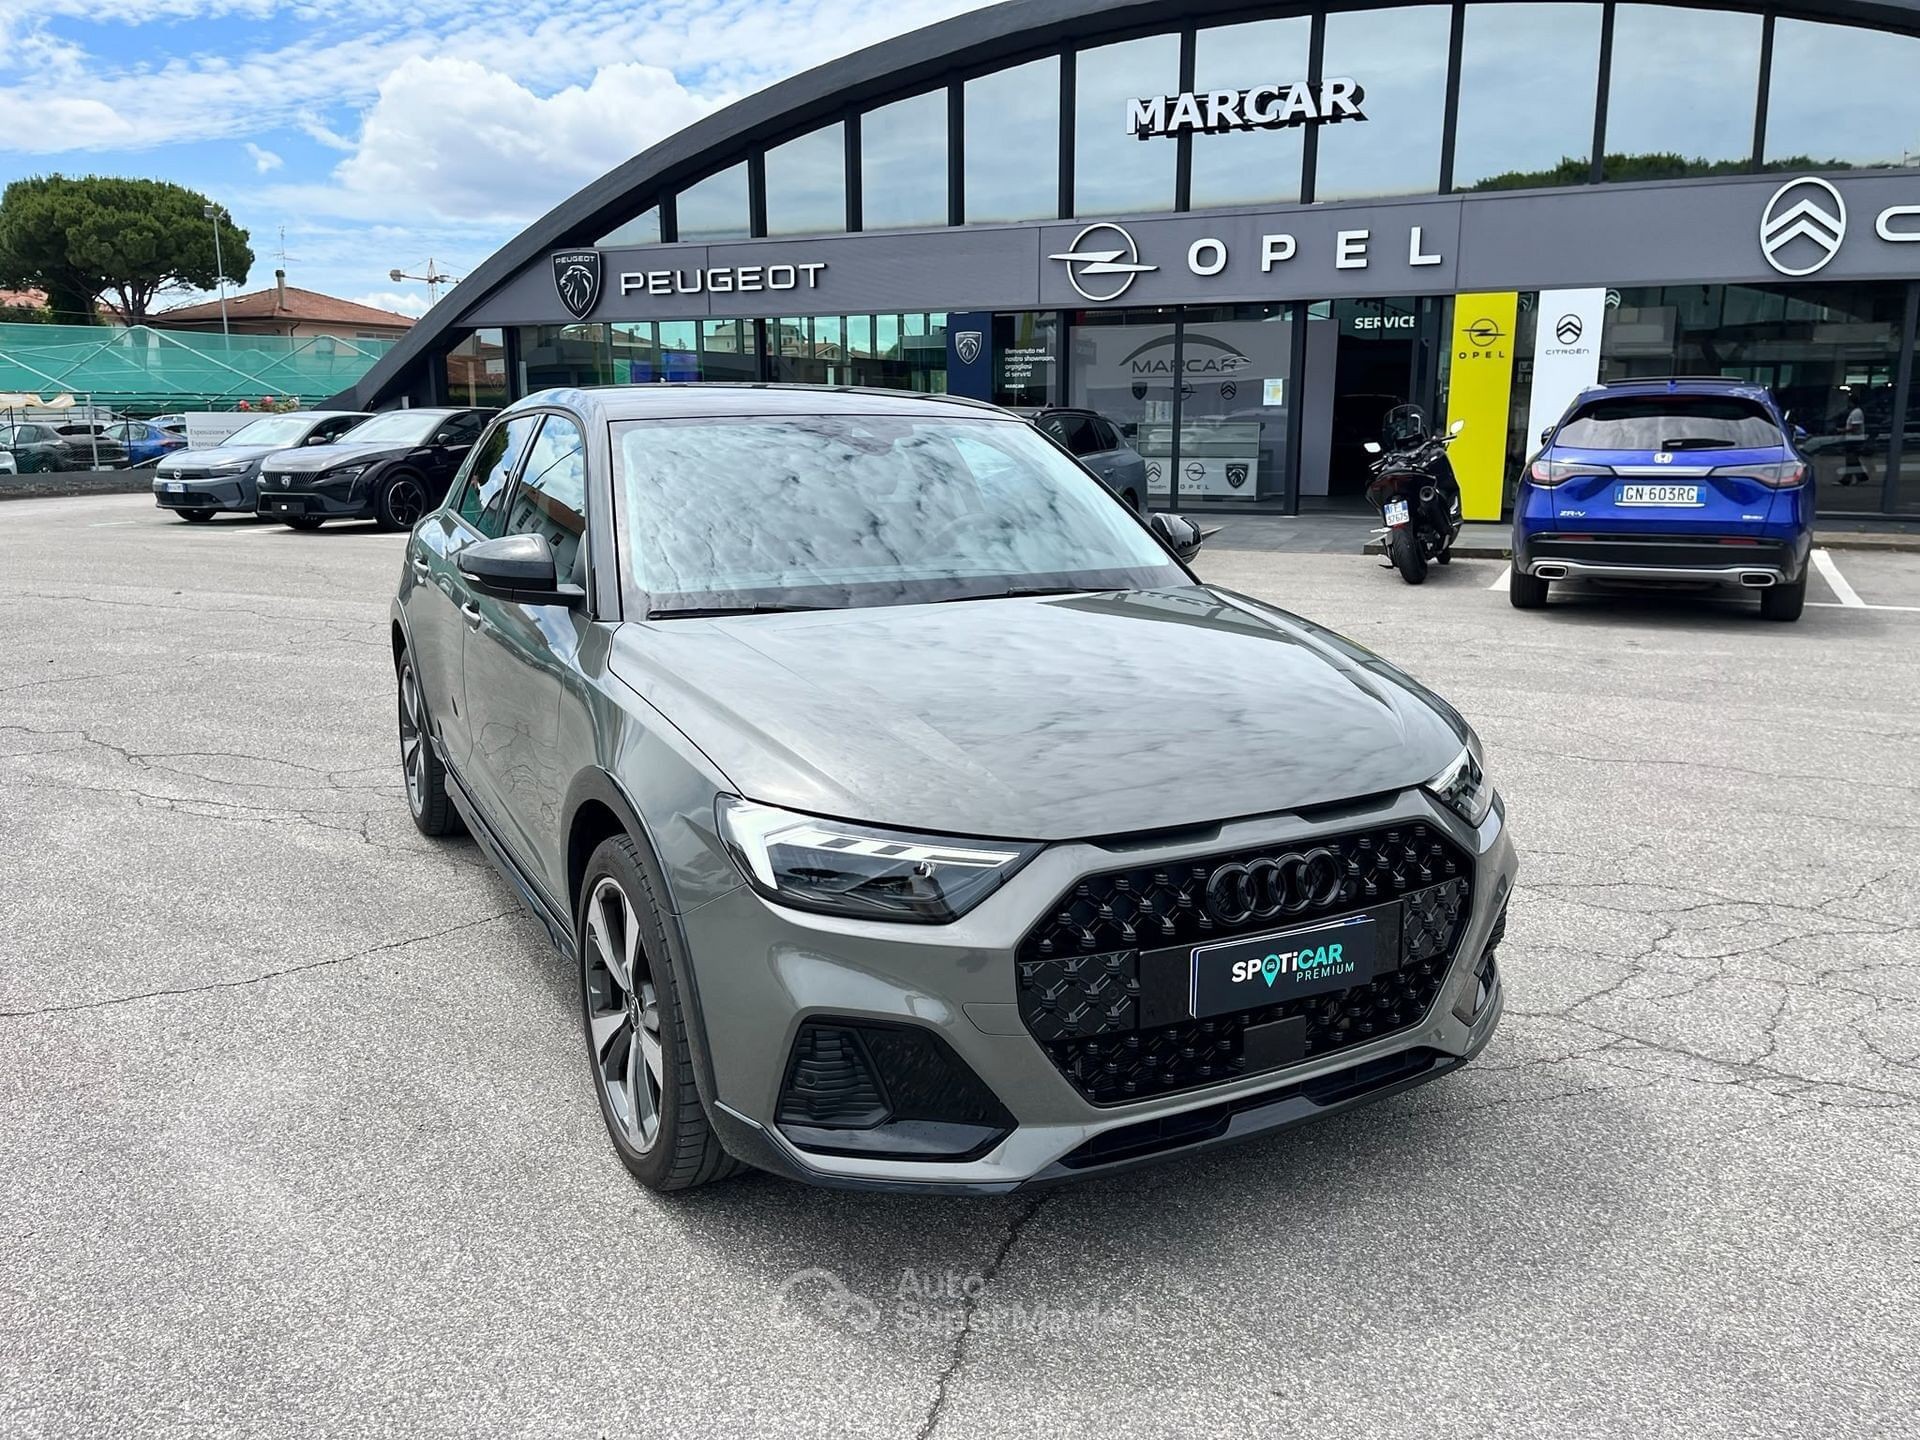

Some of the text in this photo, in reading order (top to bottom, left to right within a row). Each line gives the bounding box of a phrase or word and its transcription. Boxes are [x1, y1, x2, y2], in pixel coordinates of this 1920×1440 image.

[1126, 76, 1360, 134] MARCAR
[555, 255, 596, 264] PEUGEOT
[1187, 226, 1442, 276] OPEL
[620, 263, 825, 296] PEUGEOT
[1458, 351, 1505, 360] OPEL
[1132, 359, 1238, 374] MARCAR
[1625, 487, 1645, 501] GN
[1649, 487, 1696, 501] 603RG
[1296, 961, 1355, 983] PREMIUM
